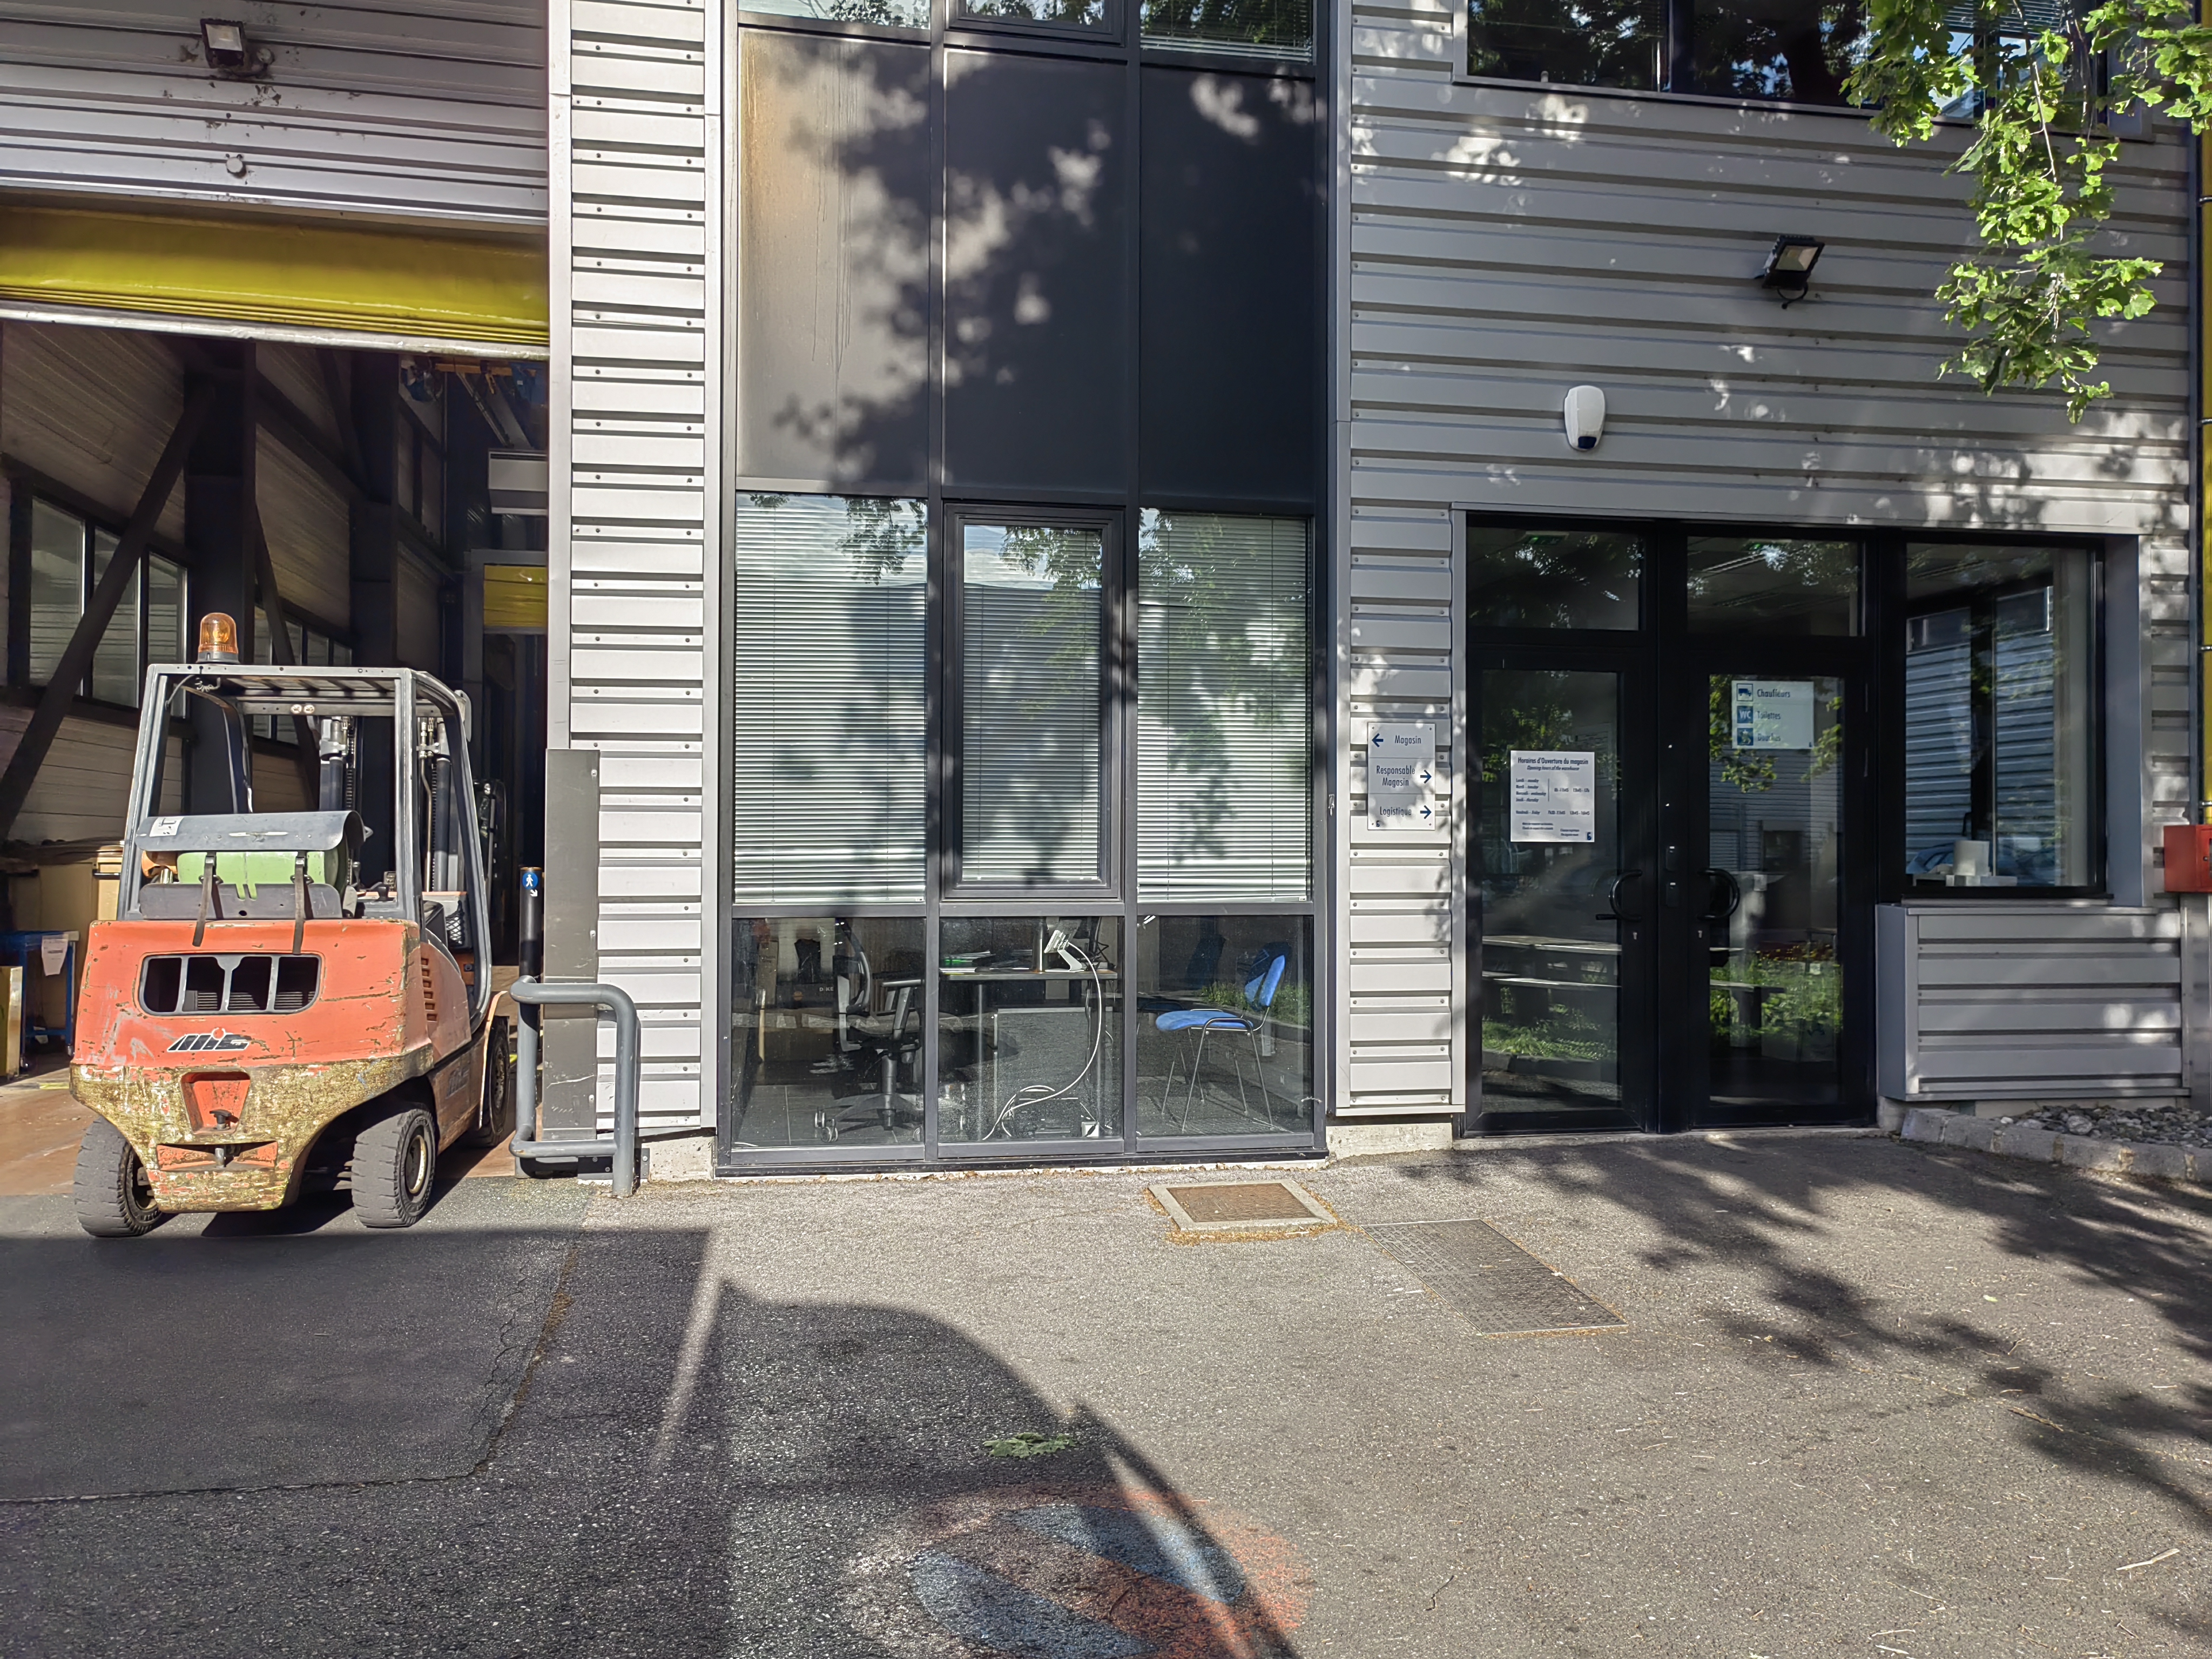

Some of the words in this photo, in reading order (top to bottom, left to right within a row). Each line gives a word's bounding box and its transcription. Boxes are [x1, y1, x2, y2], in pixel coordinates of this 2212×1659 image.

[1757, 689, 1790, 698] Chauffeurs
[1739, 710, 1751, 719] WC
[1757, 711, 1781, 719] Toilettes
[1394, 735, 1421, 746] Magasin
[1376, 765, 1415, 777] Responsable
[1382, 777, 1409, 788] Magasin
[1379, 806, 1412, 817] Logistique
